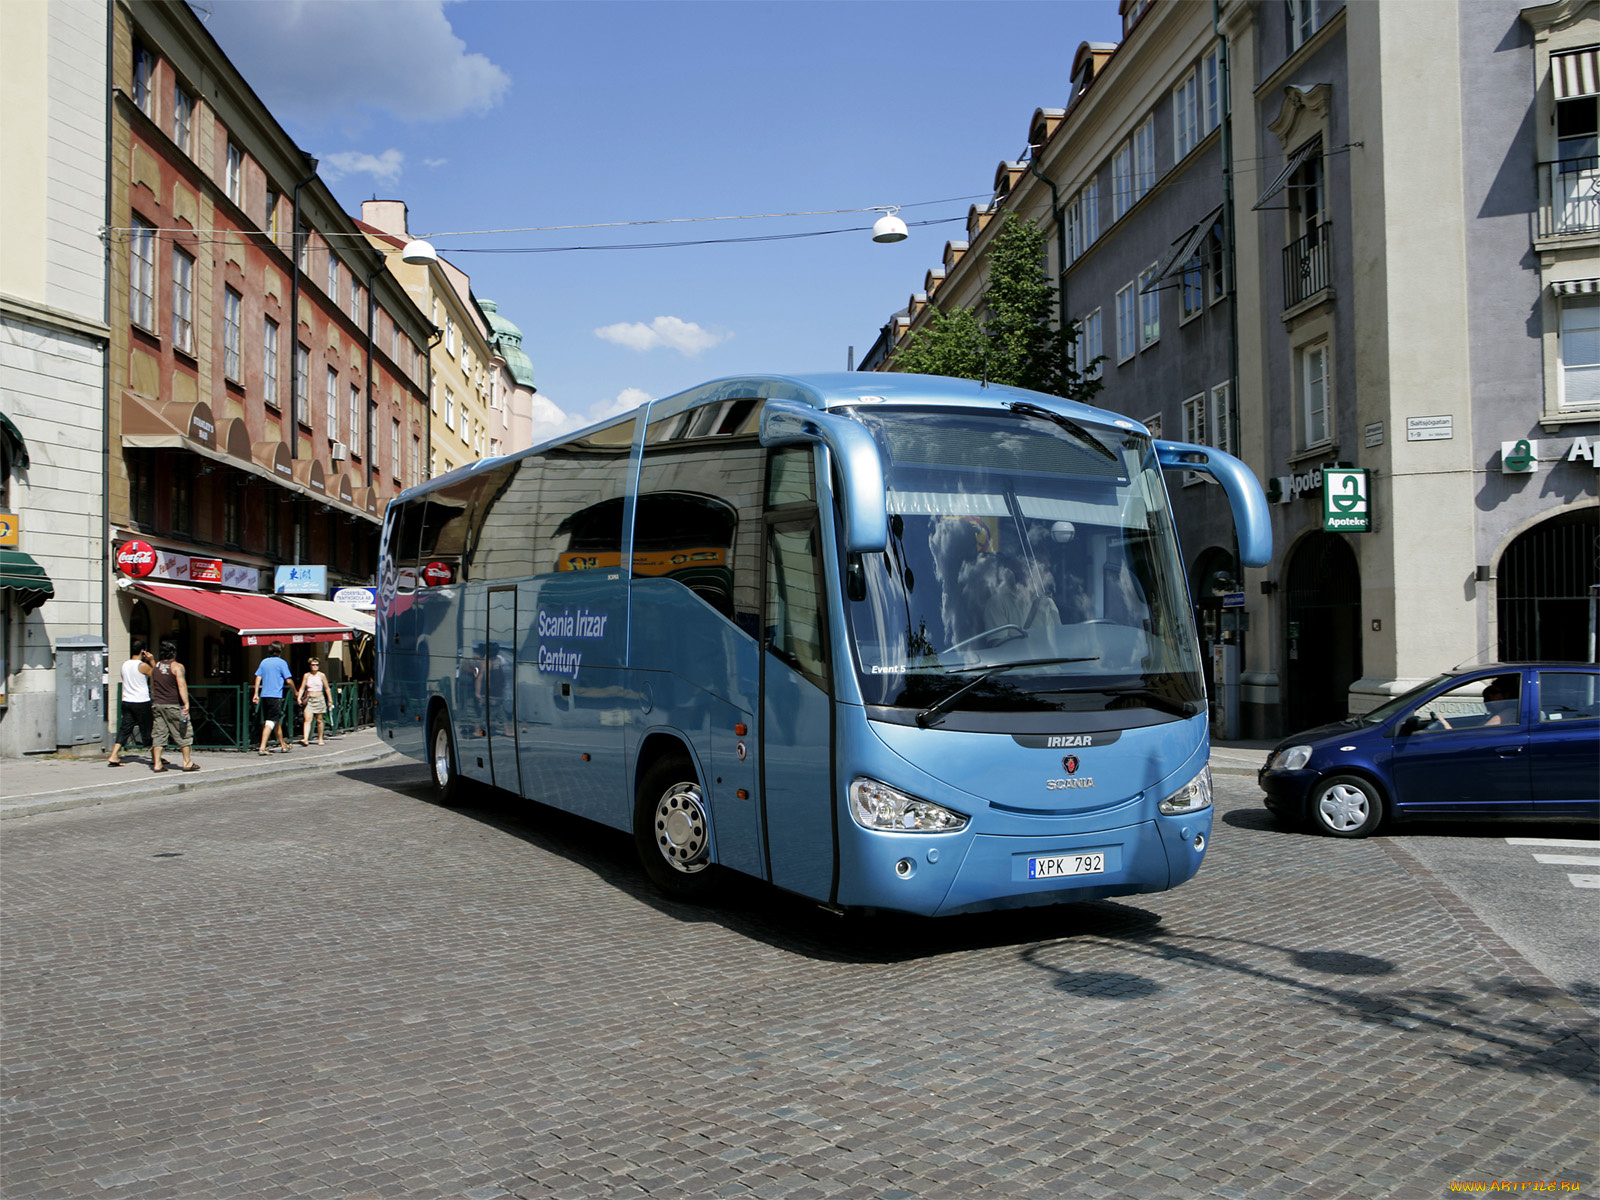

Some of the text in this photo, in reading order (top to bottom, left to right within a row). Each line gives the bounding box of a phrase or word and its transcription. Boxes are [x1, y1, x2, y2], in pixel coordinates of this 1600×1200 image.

[1328, 517, 1369, 528] Apoteket
[192, 571, 217, 579] PIZZA
[538, 609, 608, 637] Scania Irizar
[538, 645, 582, 680] Century
[871, 664, 906, 674] Event 5
[1047, 735, 1093, 748] IRIZAR
[1046, 777, 1095, 791] SCANIA
[1038, 858, 1064, 876] XPK
[1075, 855, 1101, 873] 792
